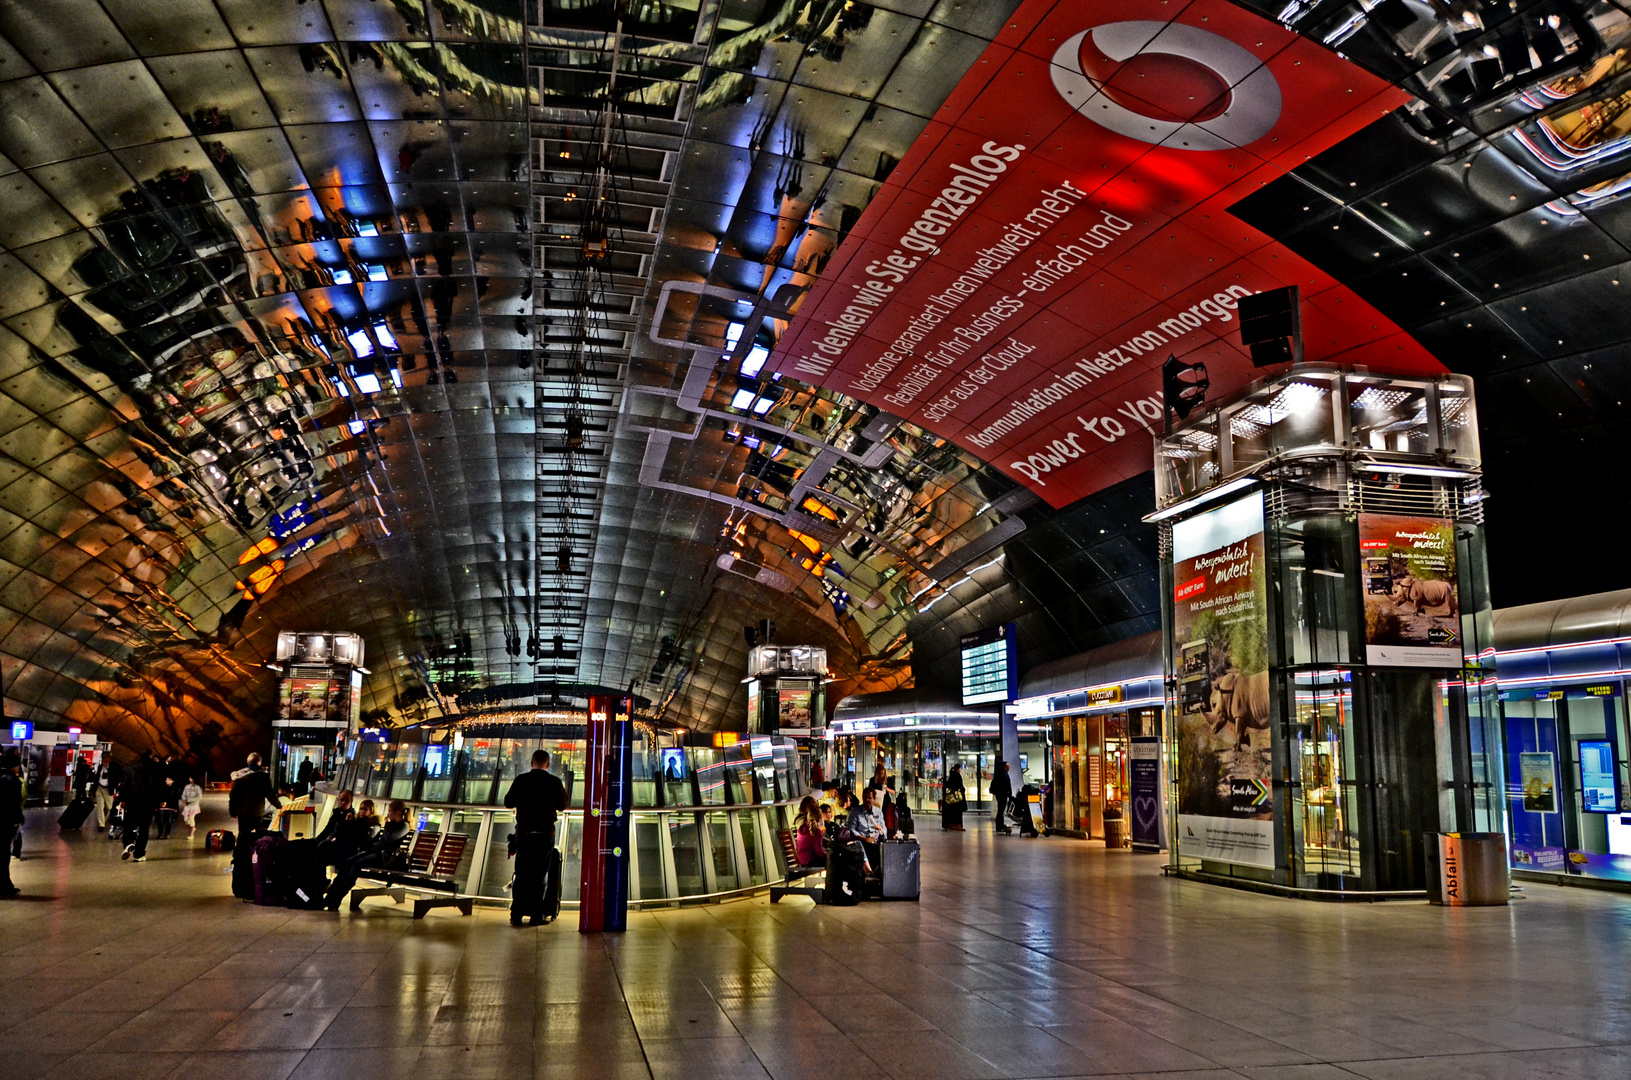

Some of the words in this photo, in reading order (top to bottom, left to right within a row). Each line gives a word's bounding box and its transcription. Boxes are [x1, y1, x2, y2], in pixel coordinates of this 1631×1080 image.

[900, 140, 1026, 255] grenzenlos.
[1079, 209, 1134, 249] und
[865, 250, 922, 283] Sie:
[1022, 244, 1094, 292] einfach
[848, 349, 903, 393] Vodafone
[890, 303, 950, 357] garantiert
[928, 275, 981, 309] Ihnen
[966, 222, 1041, 278] weltweit
[1024, 179, 1087, 229] mehr
[852, 279, 894, 307] wie
[812, 307, 873, 356] denken
[953, 296, 1024, 342] Business
[924, 350, 956, 367] für
[938, 336, 971, 356] Ihr
[981, 337, 1037, 371] Cloud.
[794, 352, 833, 376] Wir
[965, 381, 1070, 449] Kommunikation
[1055, 375, 1087, 390] im
[1075, 348, 1133, 379] Netz
[1120, 329, 1169, 352] von
[1158, 284, 1262, 339] morgen.
[968, 360, 997, 386] der
[883, 362, 943, 408] Flexibilität
[950, 378, 979, 400] aus
[923, 395, 960, 423] sicher
[1010, 432, 1087, 486] power
[1077, 416, 1126, 443] to
[1215, 552, 1254, 584] anders!
[1190, 602, 1199, 612] Mit
[1200, 598, 1214, 610] South
[1214, 594, 1232, 606] African
[1234, 590, 1255, 600] Airways
[1216, 608, 1228, 616] nach
[591, 712, 606, 721] SOS
[616, 713, 629, 721] Info
[1446, 858, 1458, 898] Abfall
